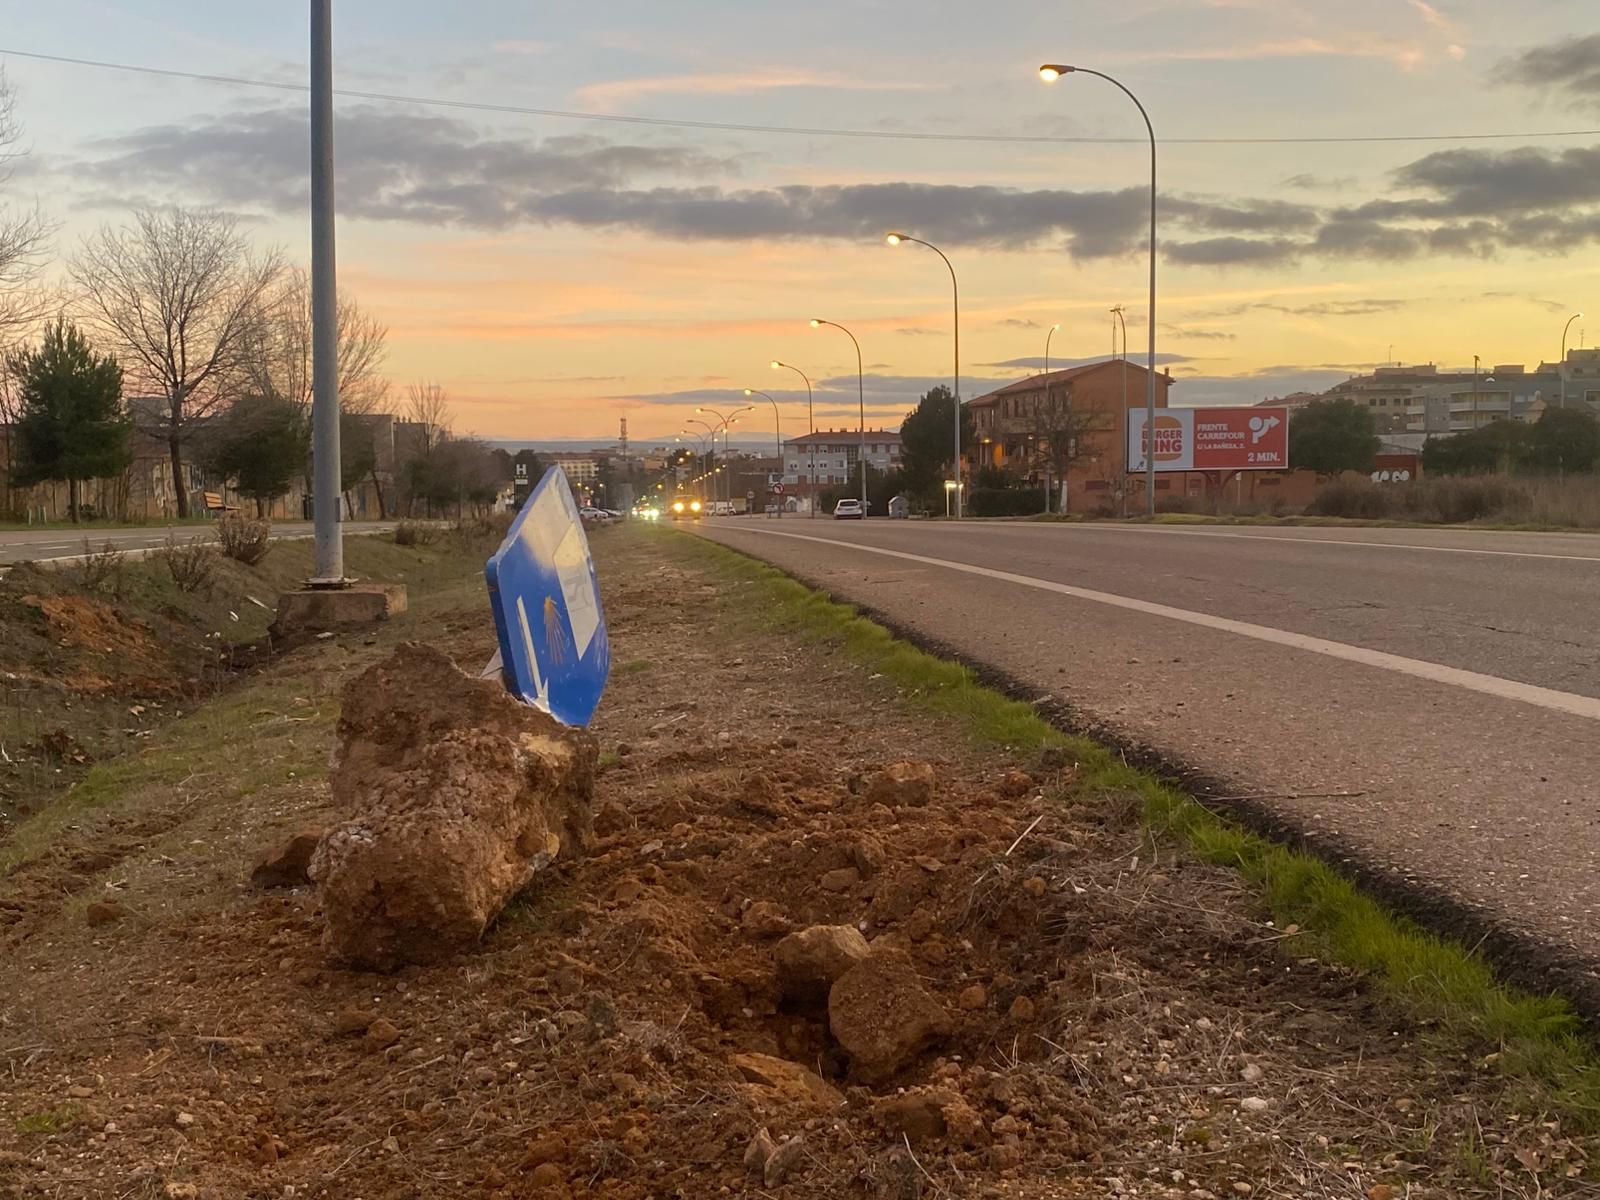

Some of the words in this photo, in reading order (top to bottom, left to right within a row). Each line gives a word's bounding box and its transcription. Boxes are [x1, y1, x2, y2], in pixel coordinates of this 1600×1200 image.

[1142, 430, 1182, 439] BRGER
[1197, 432, 1245, 440] CARREFOUR
[1247, 452, 1255, 462] 2
[1257, 452, 1281, 462] MIN.
[516, 464, 527, 475] H
